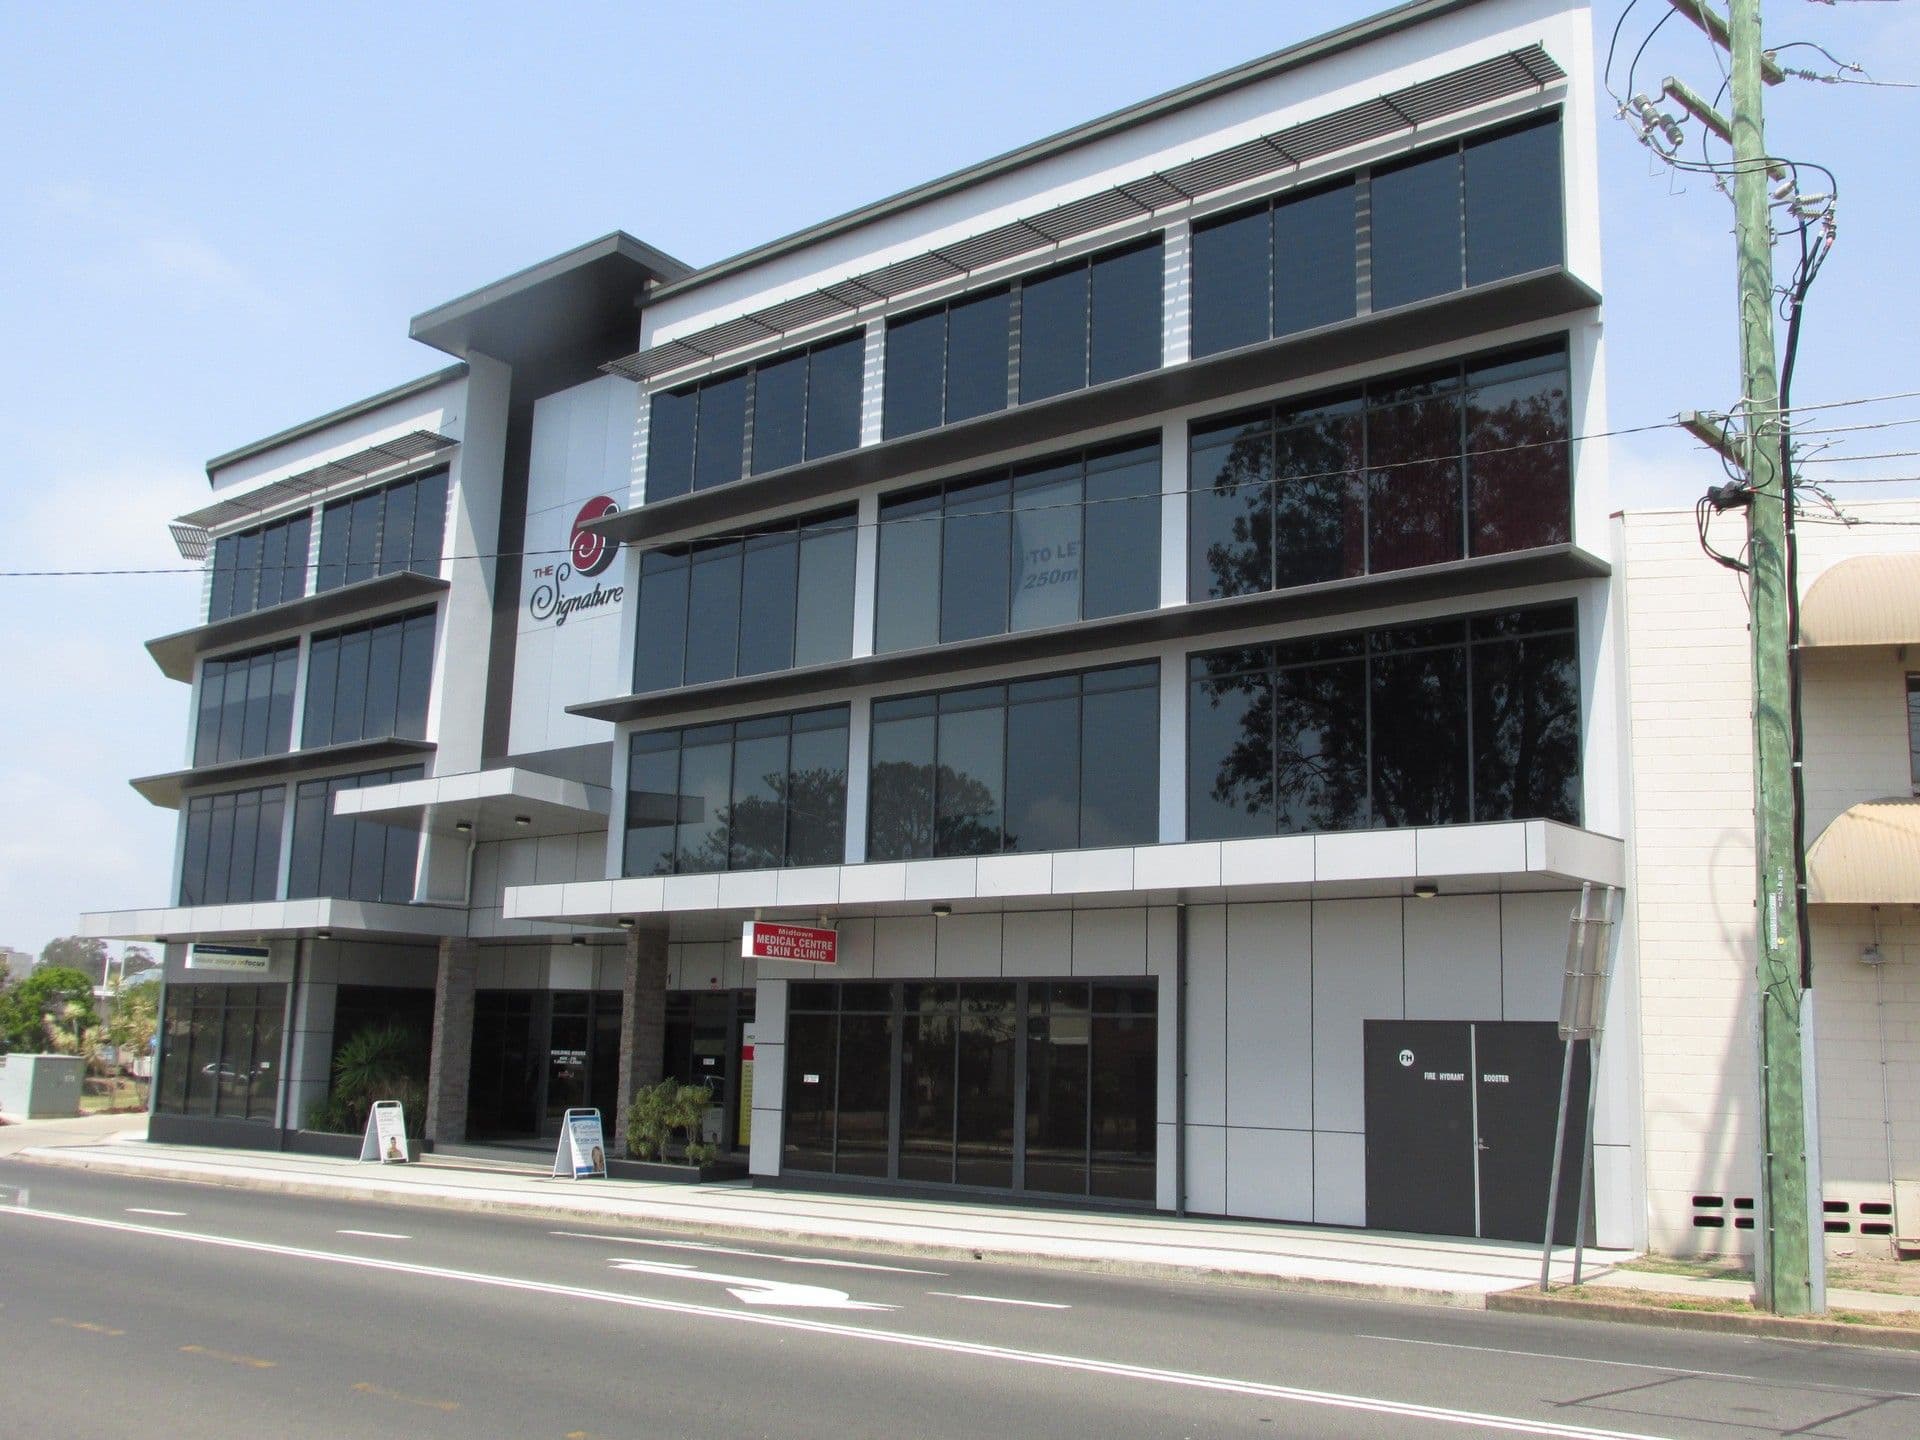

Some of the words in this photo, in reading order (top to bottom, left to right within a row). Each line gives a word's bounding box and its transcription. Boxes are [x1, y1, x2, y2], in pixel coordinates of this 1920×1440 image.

[533, 565, 553, 578] THE
[530, 562, 624, 627] Signature
[778, 929, 813, 937] Midtown
[757, 934, 796, 946] MEDICAL
[799, 939, 832, 950] CENTRE
[767, 945, 790, 956] SKIN
[794, 948, 826, 959] CLINIC
[1400, 1054, 1413, 1062] FH
[1424, 1072, 1436, 1081] FIRE
[1439, 1072, 1464, 1081] HYDRANT
[1483, 1074, 1510, 1083] BOOSTER
